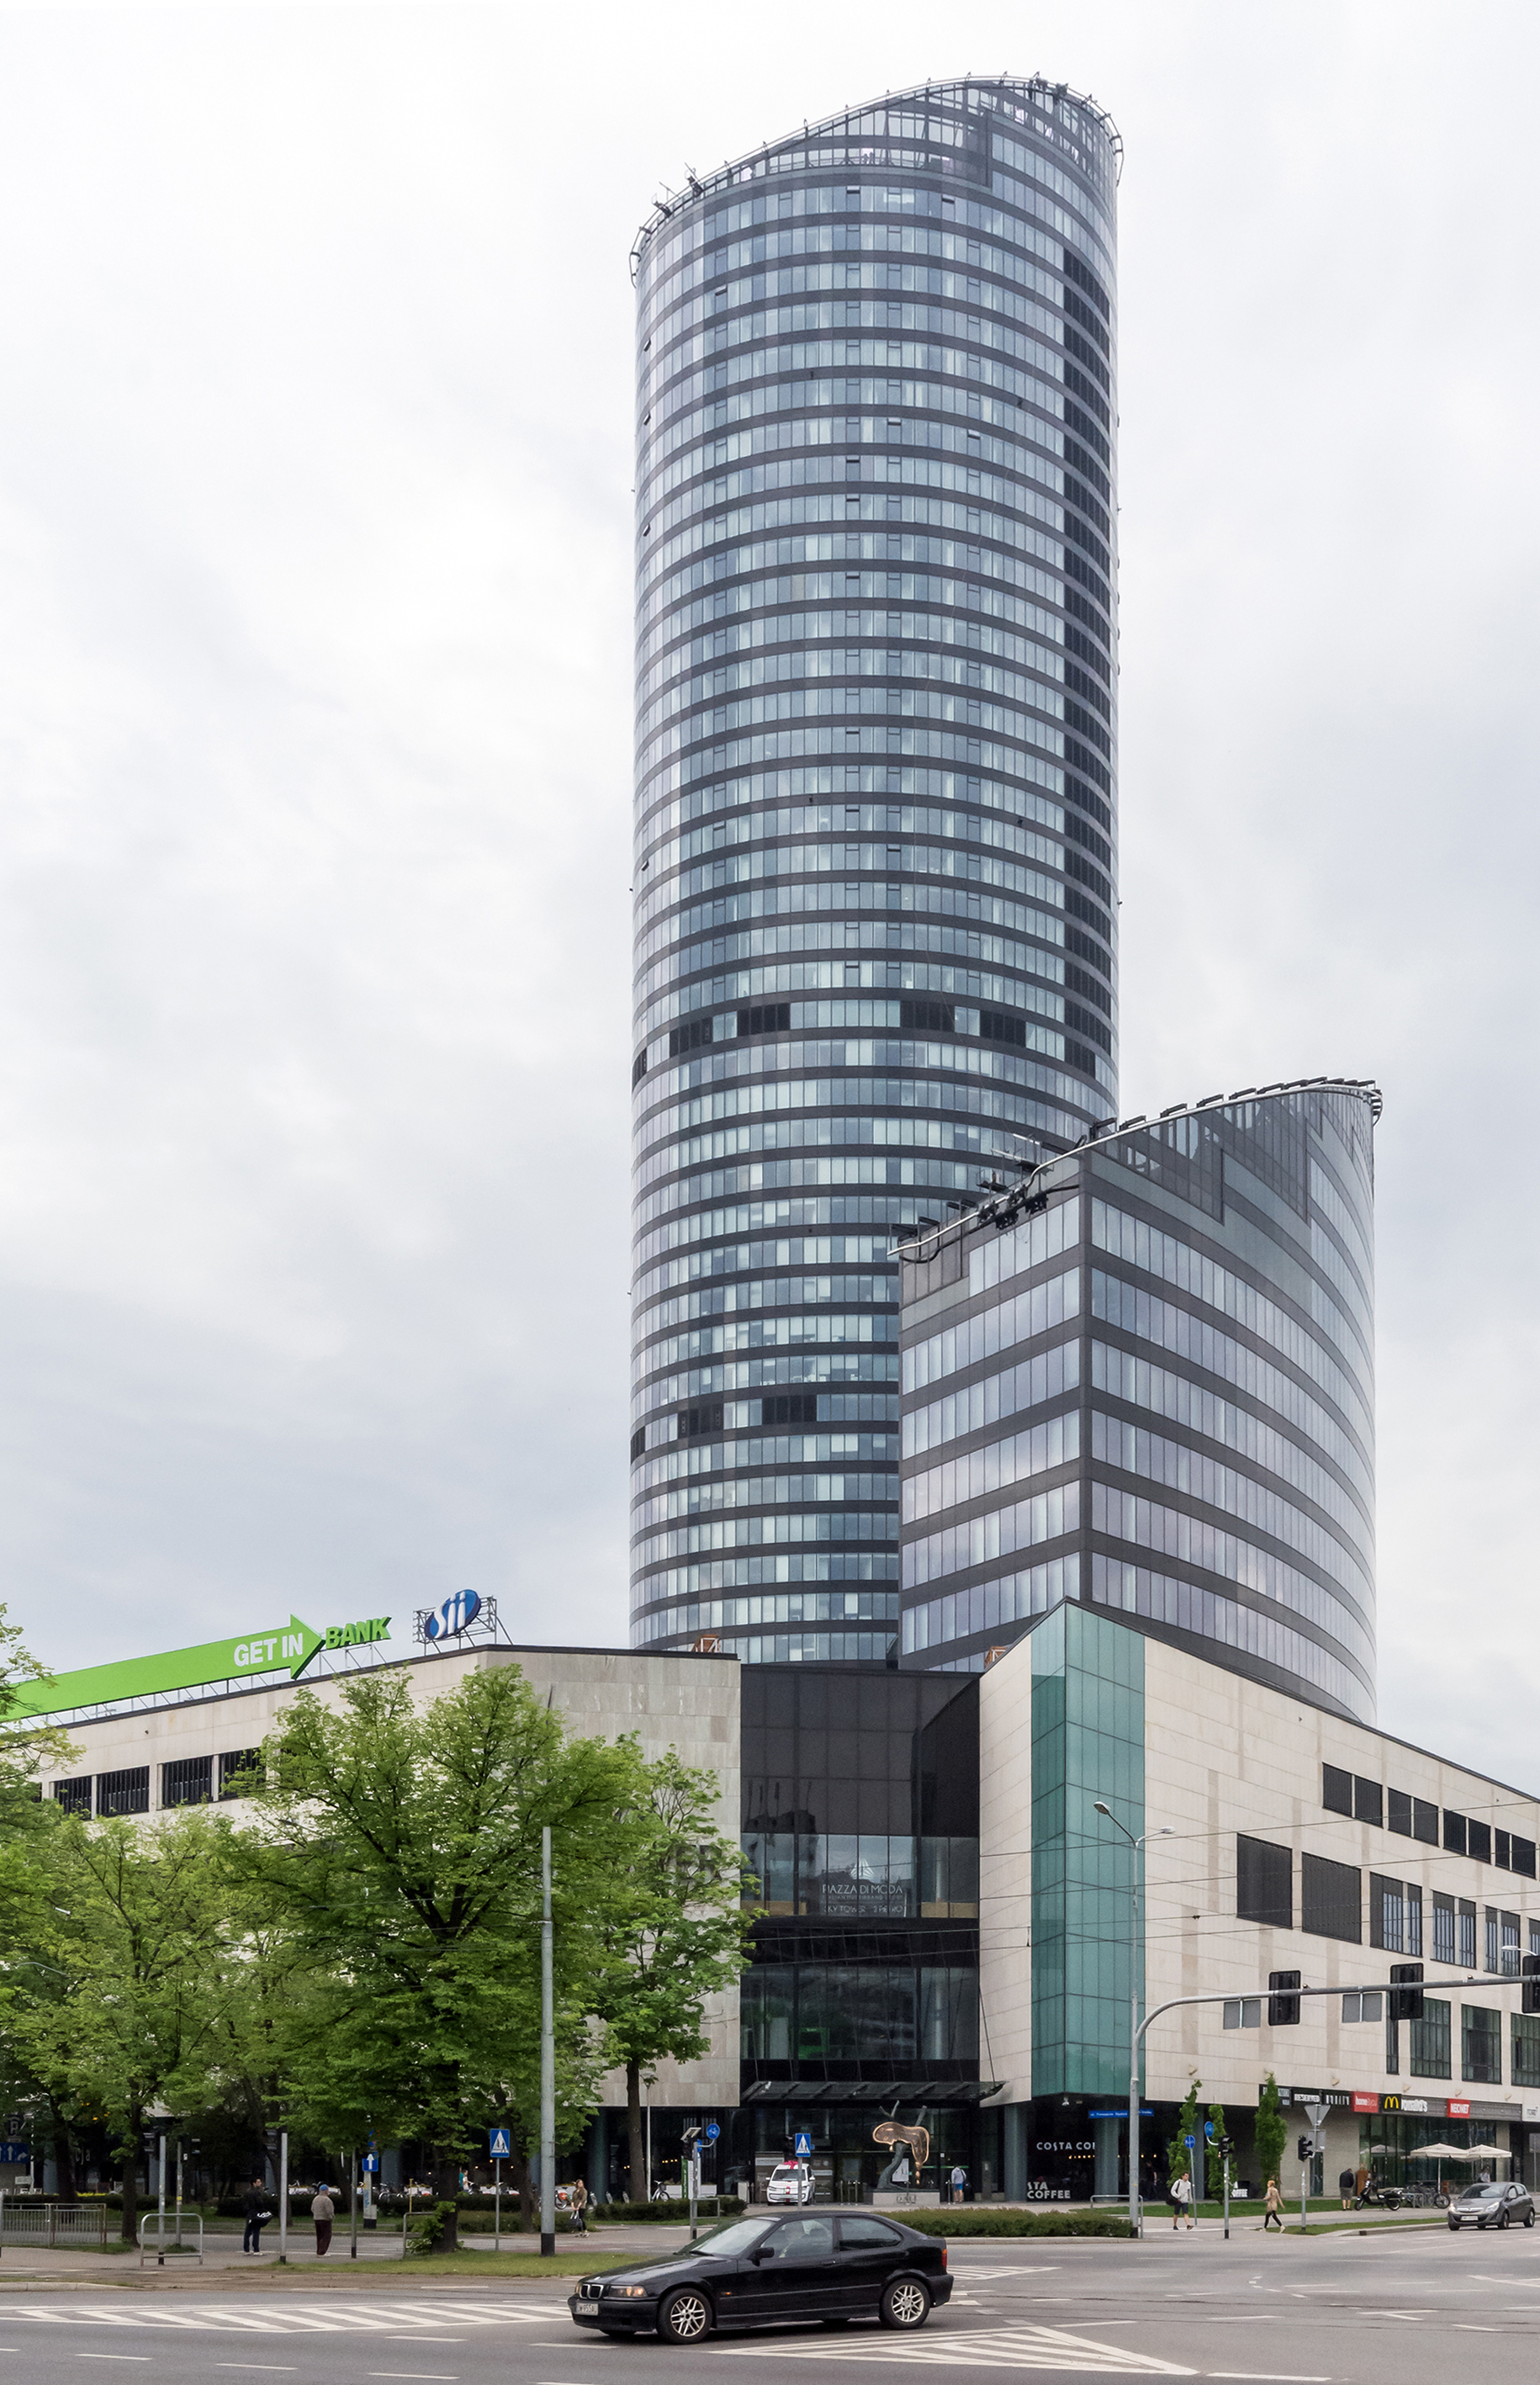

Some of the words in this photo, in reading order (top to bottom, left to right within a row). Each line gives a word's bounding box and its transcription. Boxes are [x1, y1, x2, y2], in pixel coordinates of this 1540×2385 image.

[325, 1616, 392, 1650] BANK
[234, 1638, 278, 1667] GET
[282, 1633, 304, 1658] IN
[822, 1884, 858, 1894] PIAZZA
[860, 1884, 869, 1894] DI
[871, 1884, 903, 1895] MODA
[1036, 2142, 1073, 2151] COSTA
[1026, 2190, 1071, 2199] COFFEE
